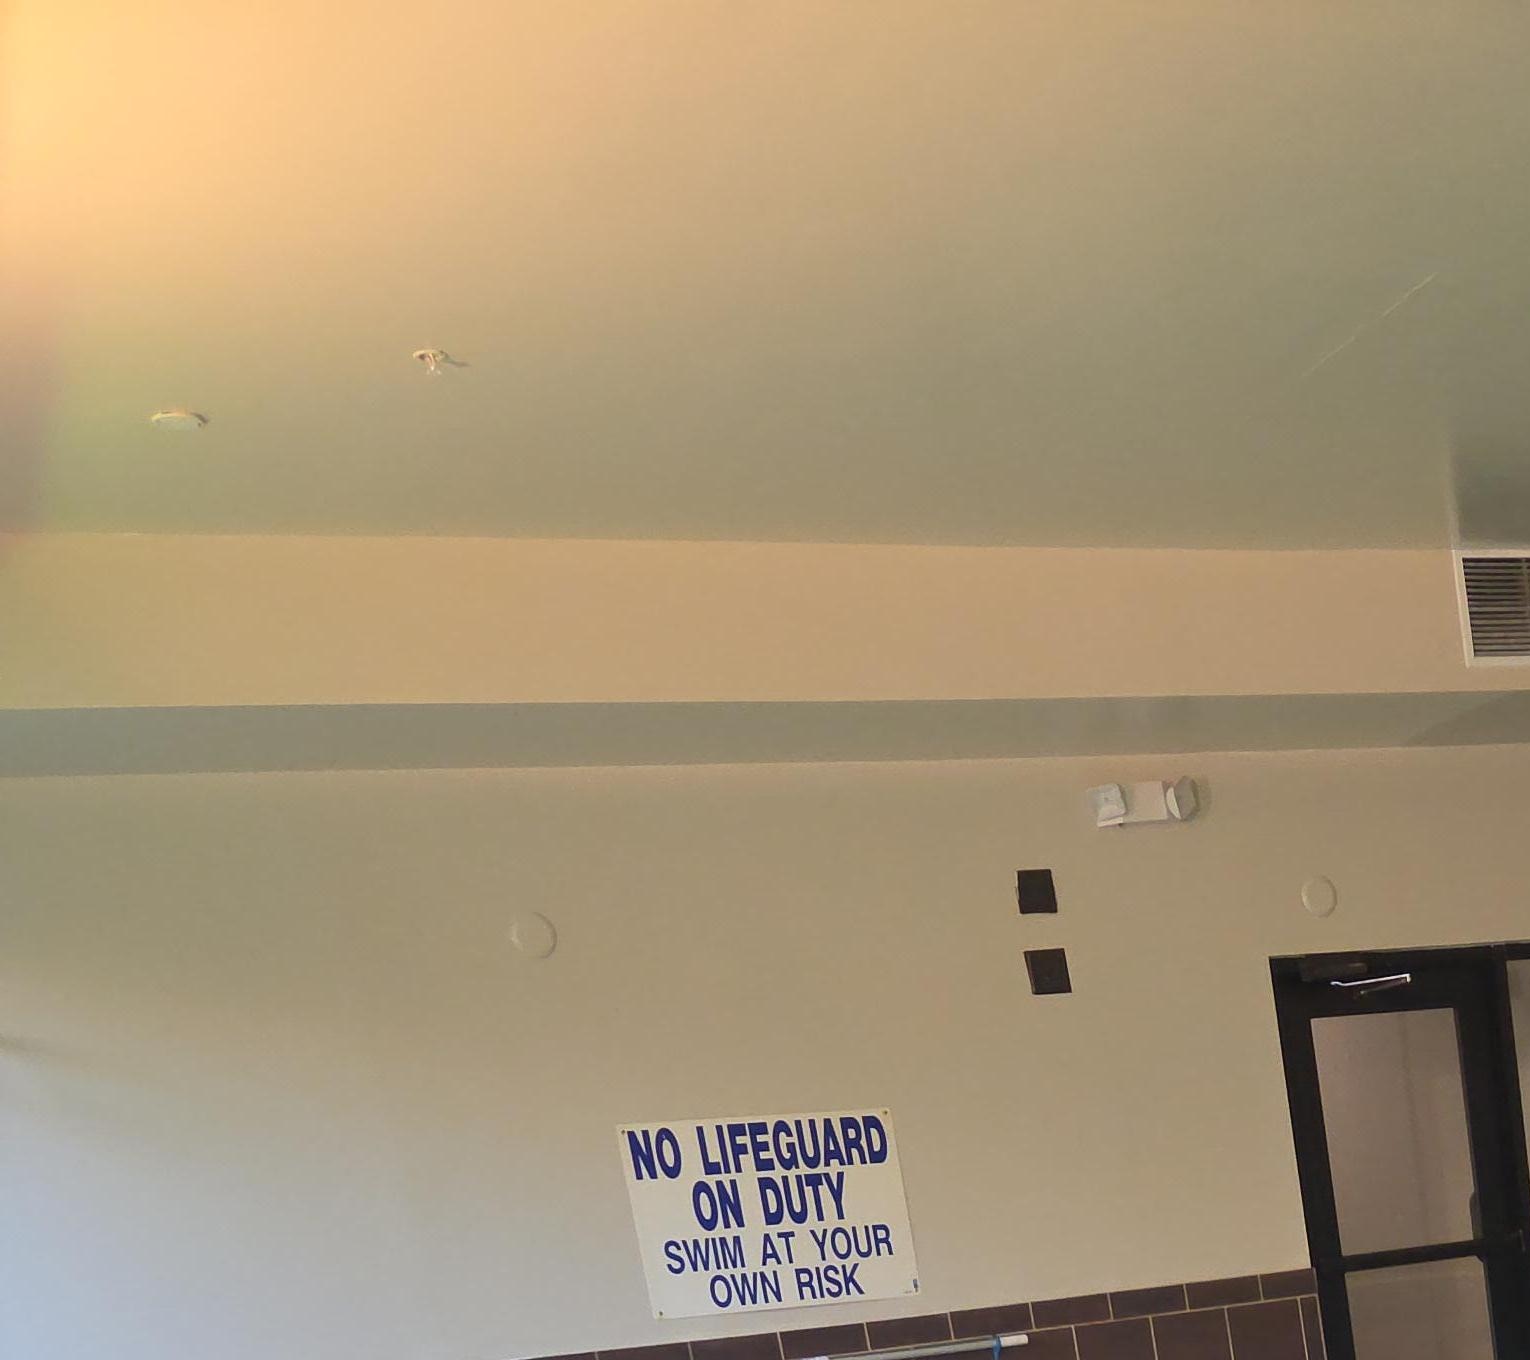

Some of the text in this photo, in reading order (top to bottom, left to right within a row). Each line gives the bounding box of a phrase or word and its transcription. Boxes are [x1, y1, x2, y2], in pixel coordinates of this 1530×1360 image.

[627, 1115, 888, 1180] NO LIFEGUARD
[692, 1171, 845, 1231] ON DUTY
[664, 1224, 894, 1275] SWIM AT YOUR
[710, 1263, 865, 1308] OWN RISK
